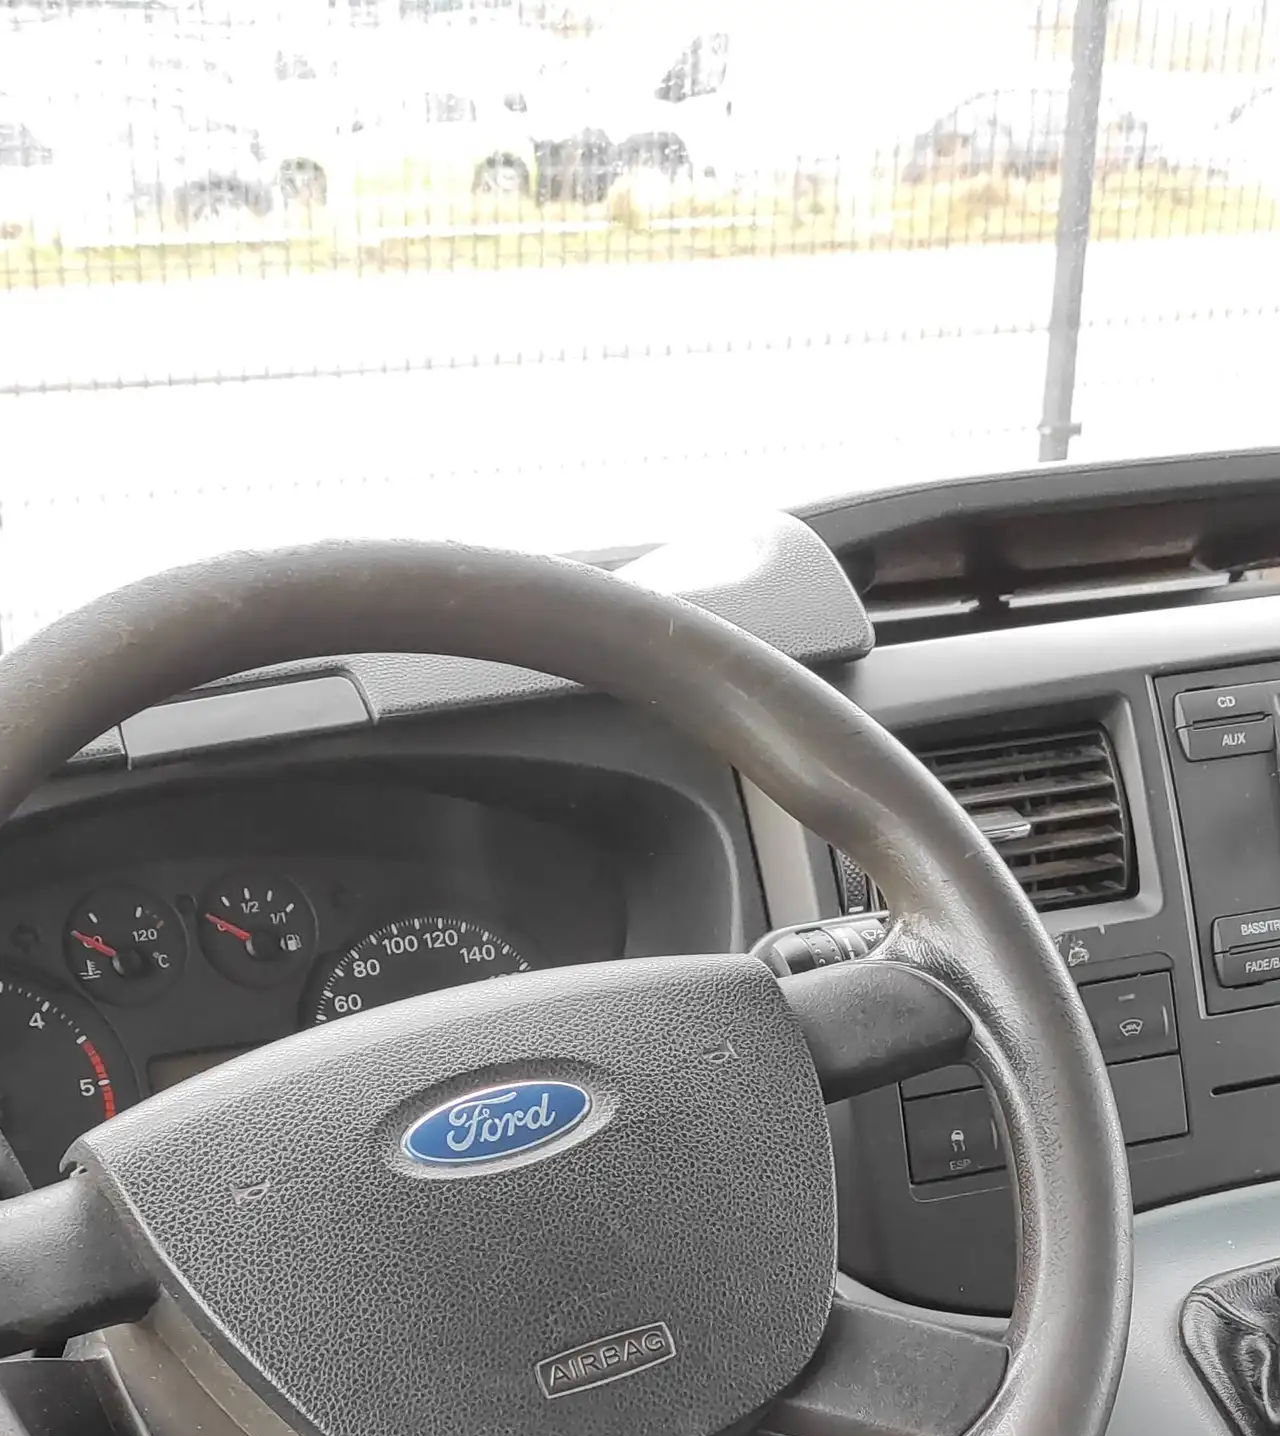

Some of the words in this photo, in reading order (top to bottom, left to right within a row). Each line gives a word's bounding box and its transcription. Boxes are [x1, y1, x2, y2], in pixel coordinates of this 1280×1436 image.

[1217, 696, 1236, 708] CD
[1222, 732, 1246, 746] AUX
[241, 901, 261, 914] 1/2
[270, 911, 287, 925] 1/1
[132, 928, 158, 942] 120
[422, 929, 458, 948] 120
[381, 935, 418, 955] 100
[459, 944, 496, 964] 140
[352, 959, 381, 978] 80
[334, 994, 362, 1013] 60
[28, 1012, 45, 1030] 4
[79, 1078, 95, 1096] 5
[446, 1091, 556, 1152] Ford
[949, 1158, 971, 1171] ESP
[549, 1331, 665, 1388] AIRBAG
